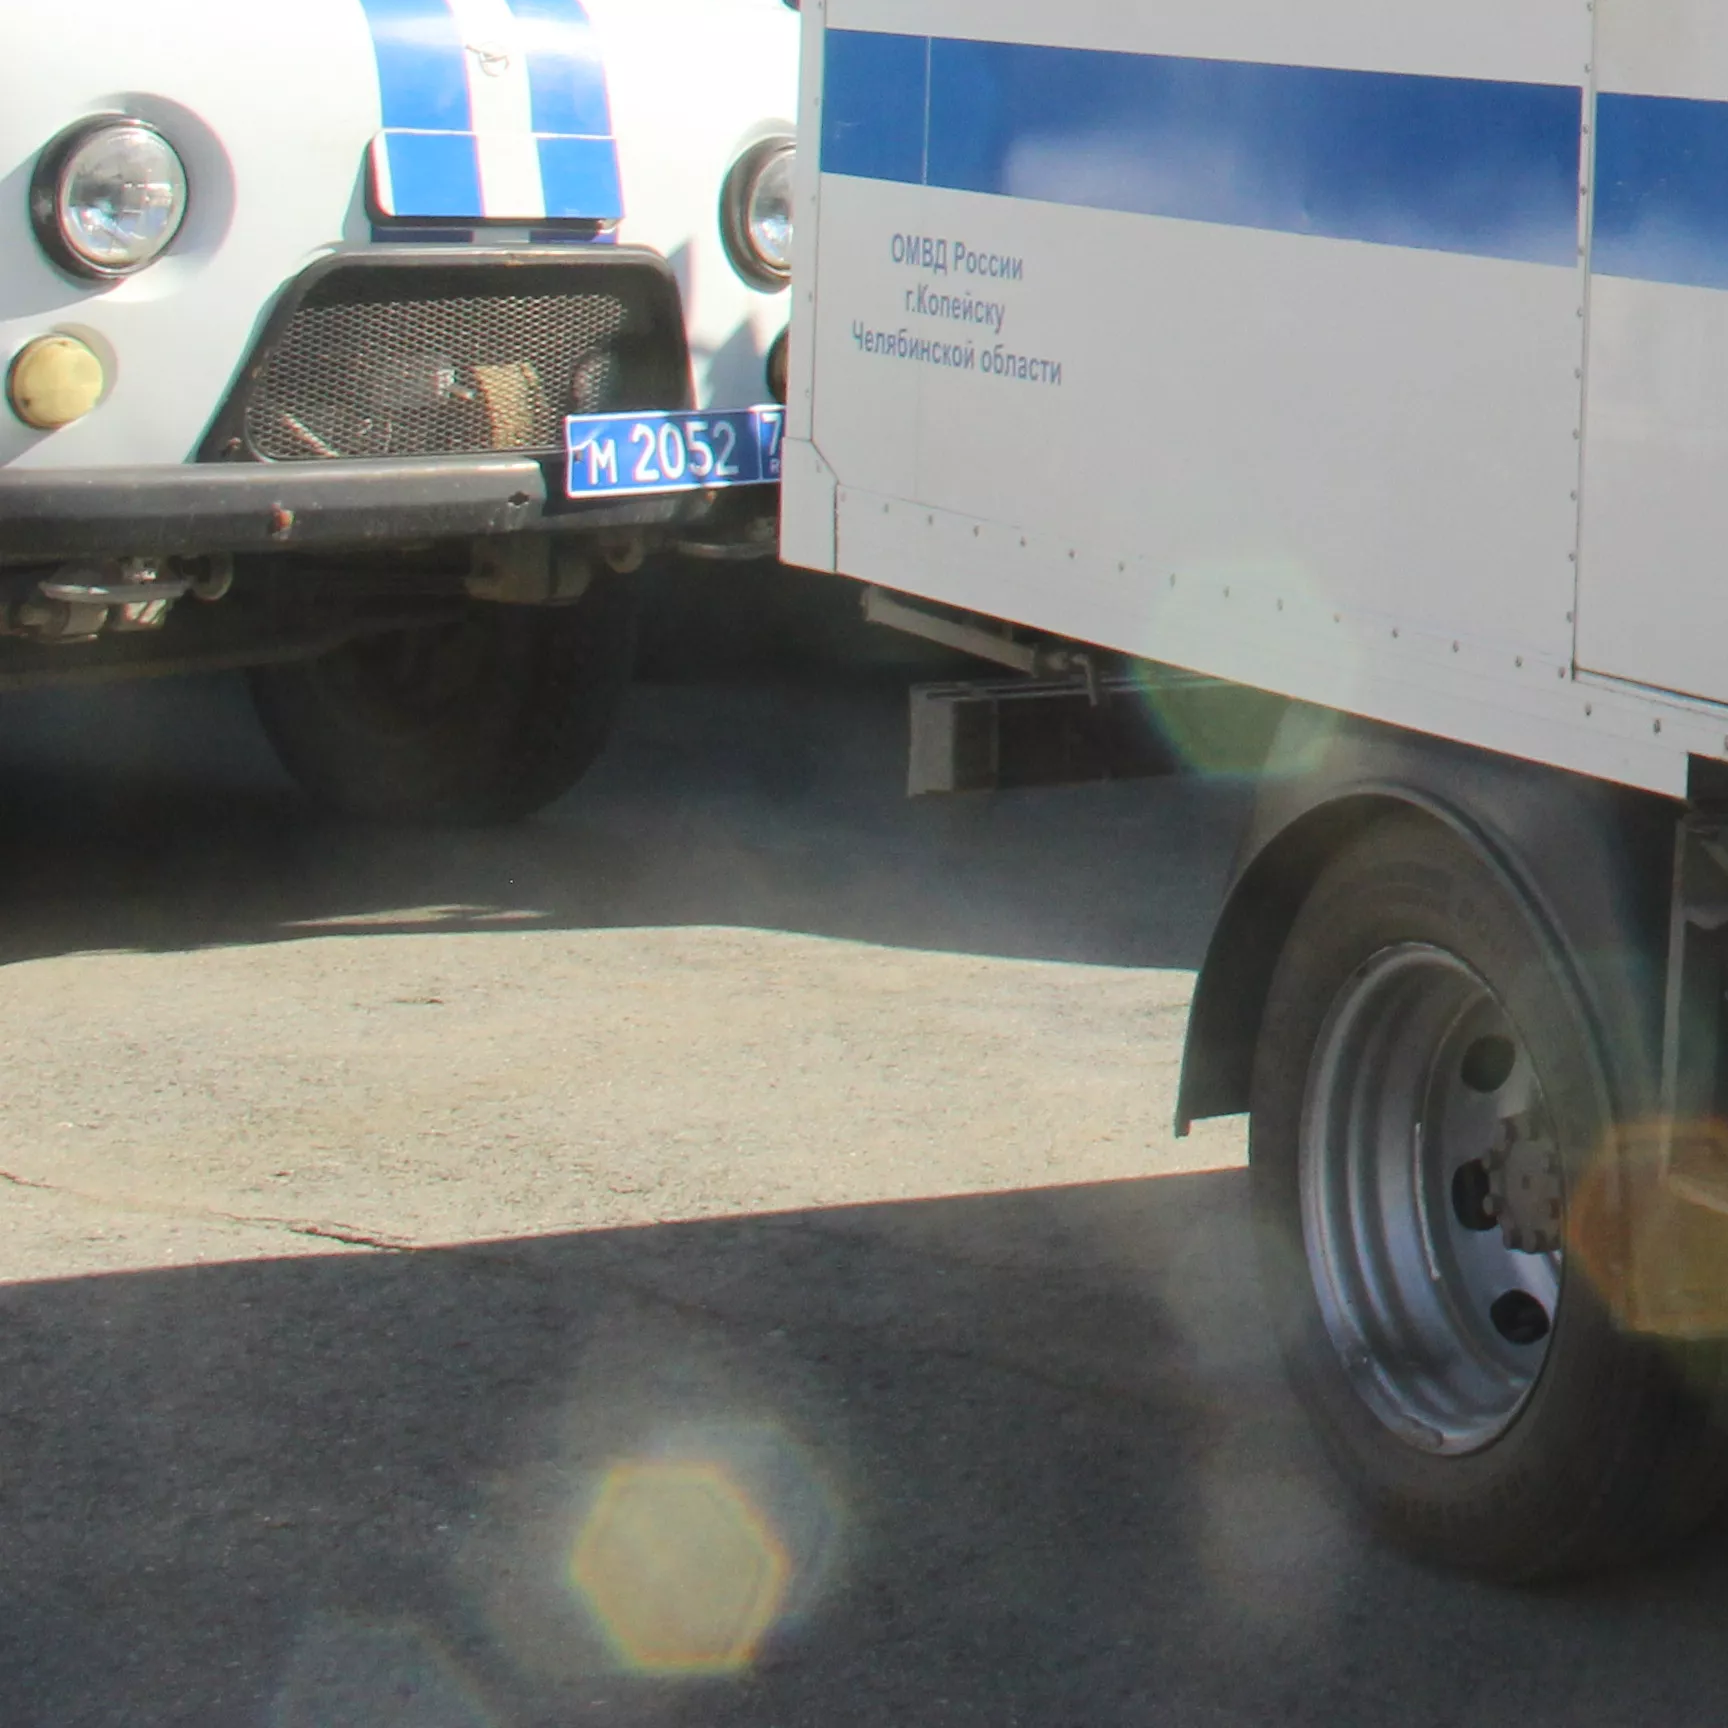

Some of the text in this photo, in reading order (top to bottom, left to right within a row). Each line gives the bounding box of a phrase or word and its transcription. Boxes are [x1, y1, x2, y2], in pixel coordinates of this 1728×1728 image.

[891, 233, 1024, 281] ОМВД России
[905, 283, 1006, 335] г.Копейску
[851, 320, 1063, 386] Челябинской области
[630, 421, 739, 482] 2052
